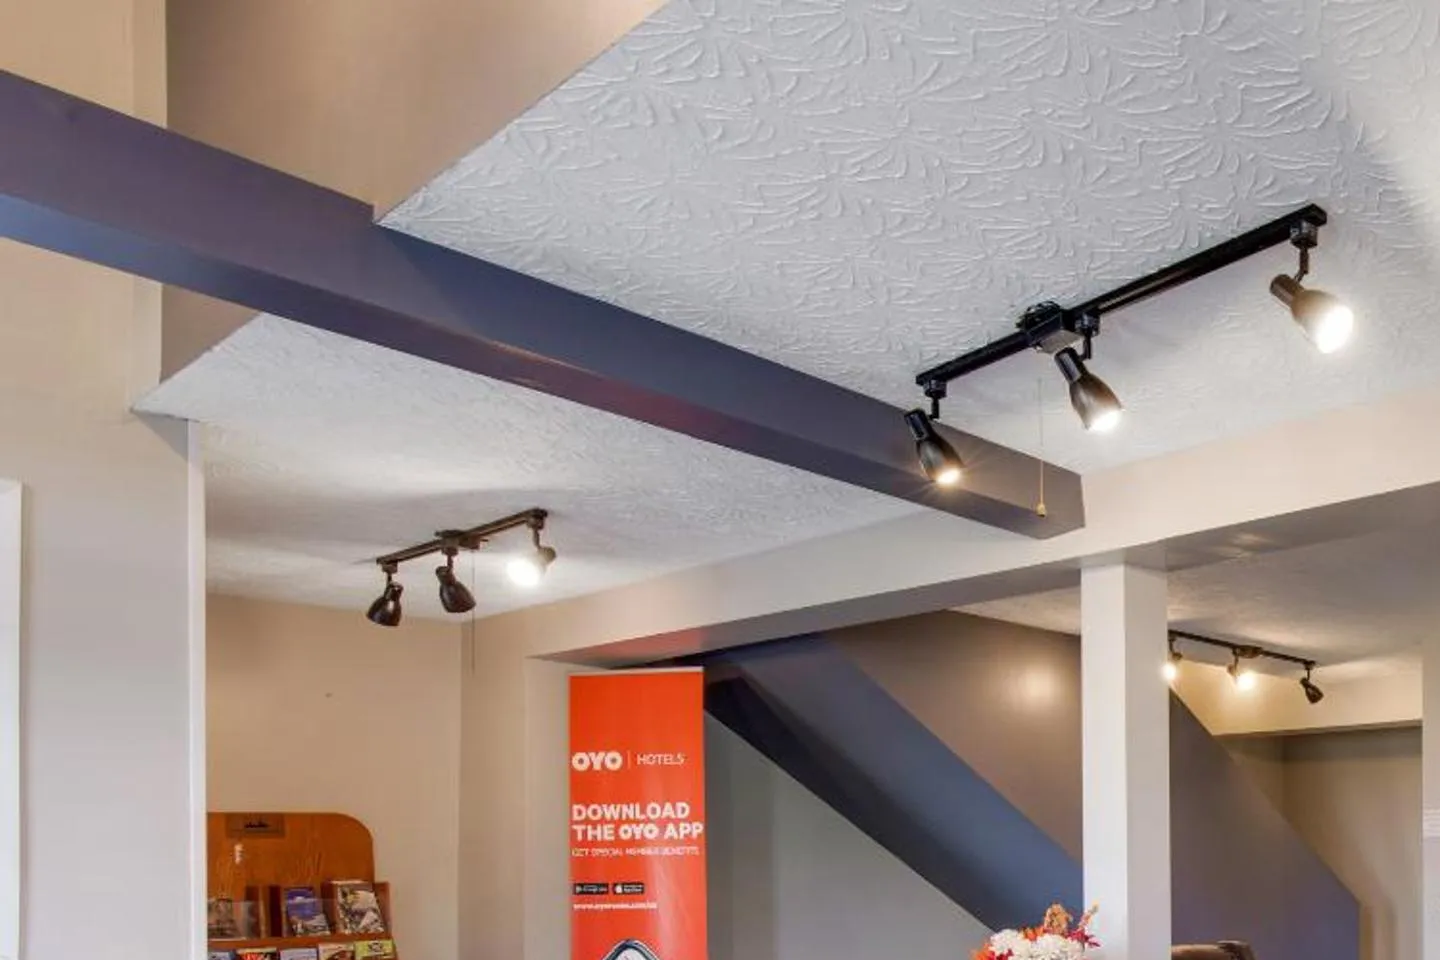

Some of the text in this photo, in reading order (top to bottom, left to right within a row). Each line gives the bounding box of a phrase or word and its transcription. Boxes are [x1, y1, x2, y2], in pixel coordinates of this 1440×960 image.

[571, 751, 685, 771] OYO HOTELS
[571, 801, 690, 821] DOWNLOAD
[571, 821, 704, 841] THE OYO APP
